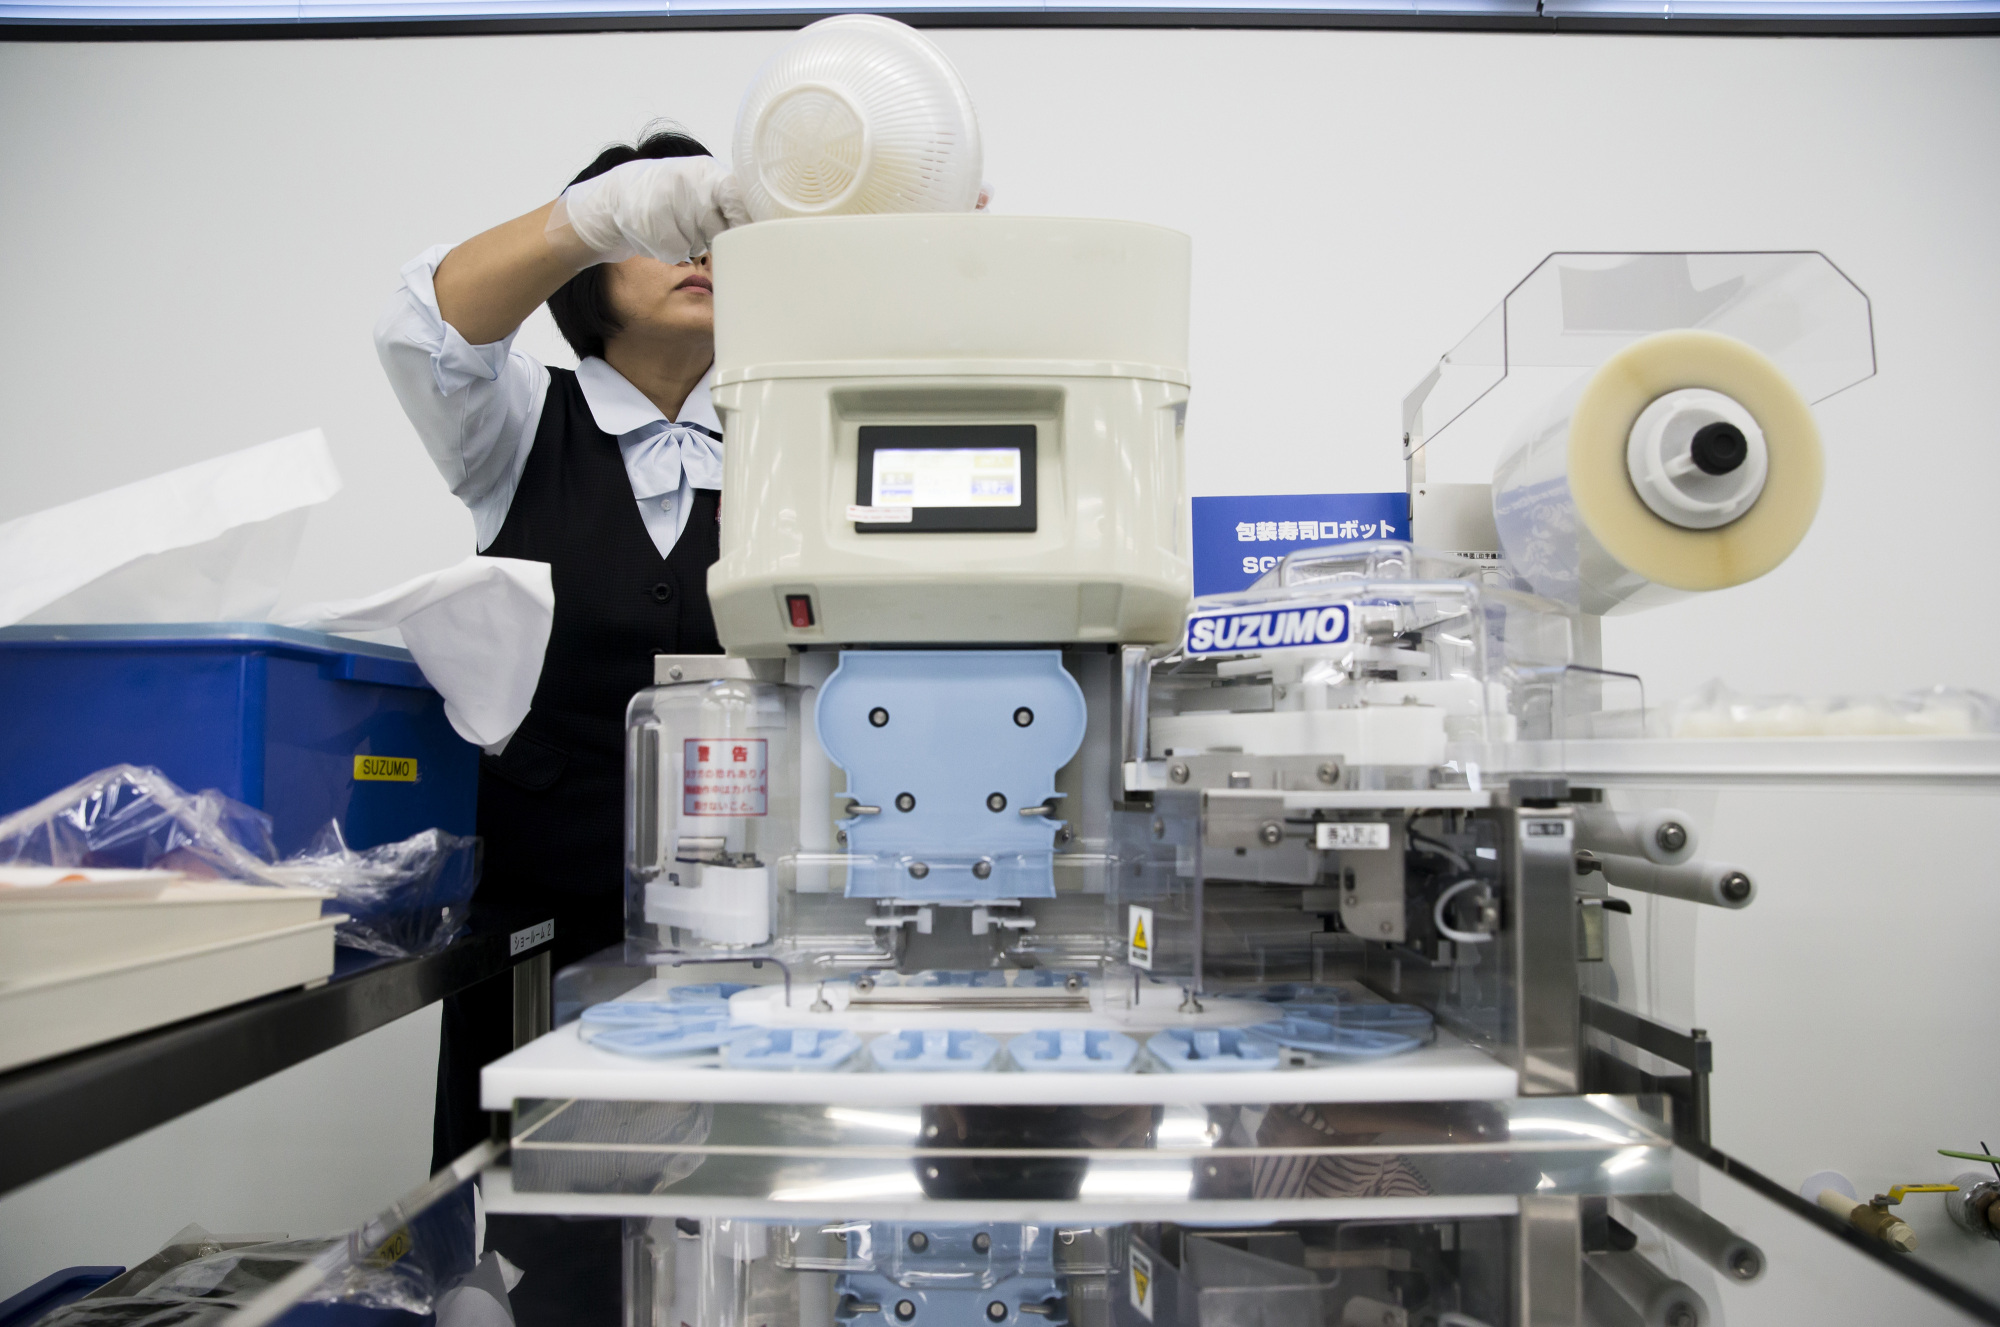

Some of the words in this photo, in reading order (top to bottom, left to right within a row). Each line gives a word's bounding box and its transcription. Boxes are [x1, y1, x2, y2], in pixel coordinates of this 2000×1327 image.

[1235, 519, 1396, 542] 包装寿司ロボット
[1190, 605, 1345, 651] SUZUMO
[363, 759, 410, 777] SUZUMO
[514, 926, 545, 951] ショールーム
